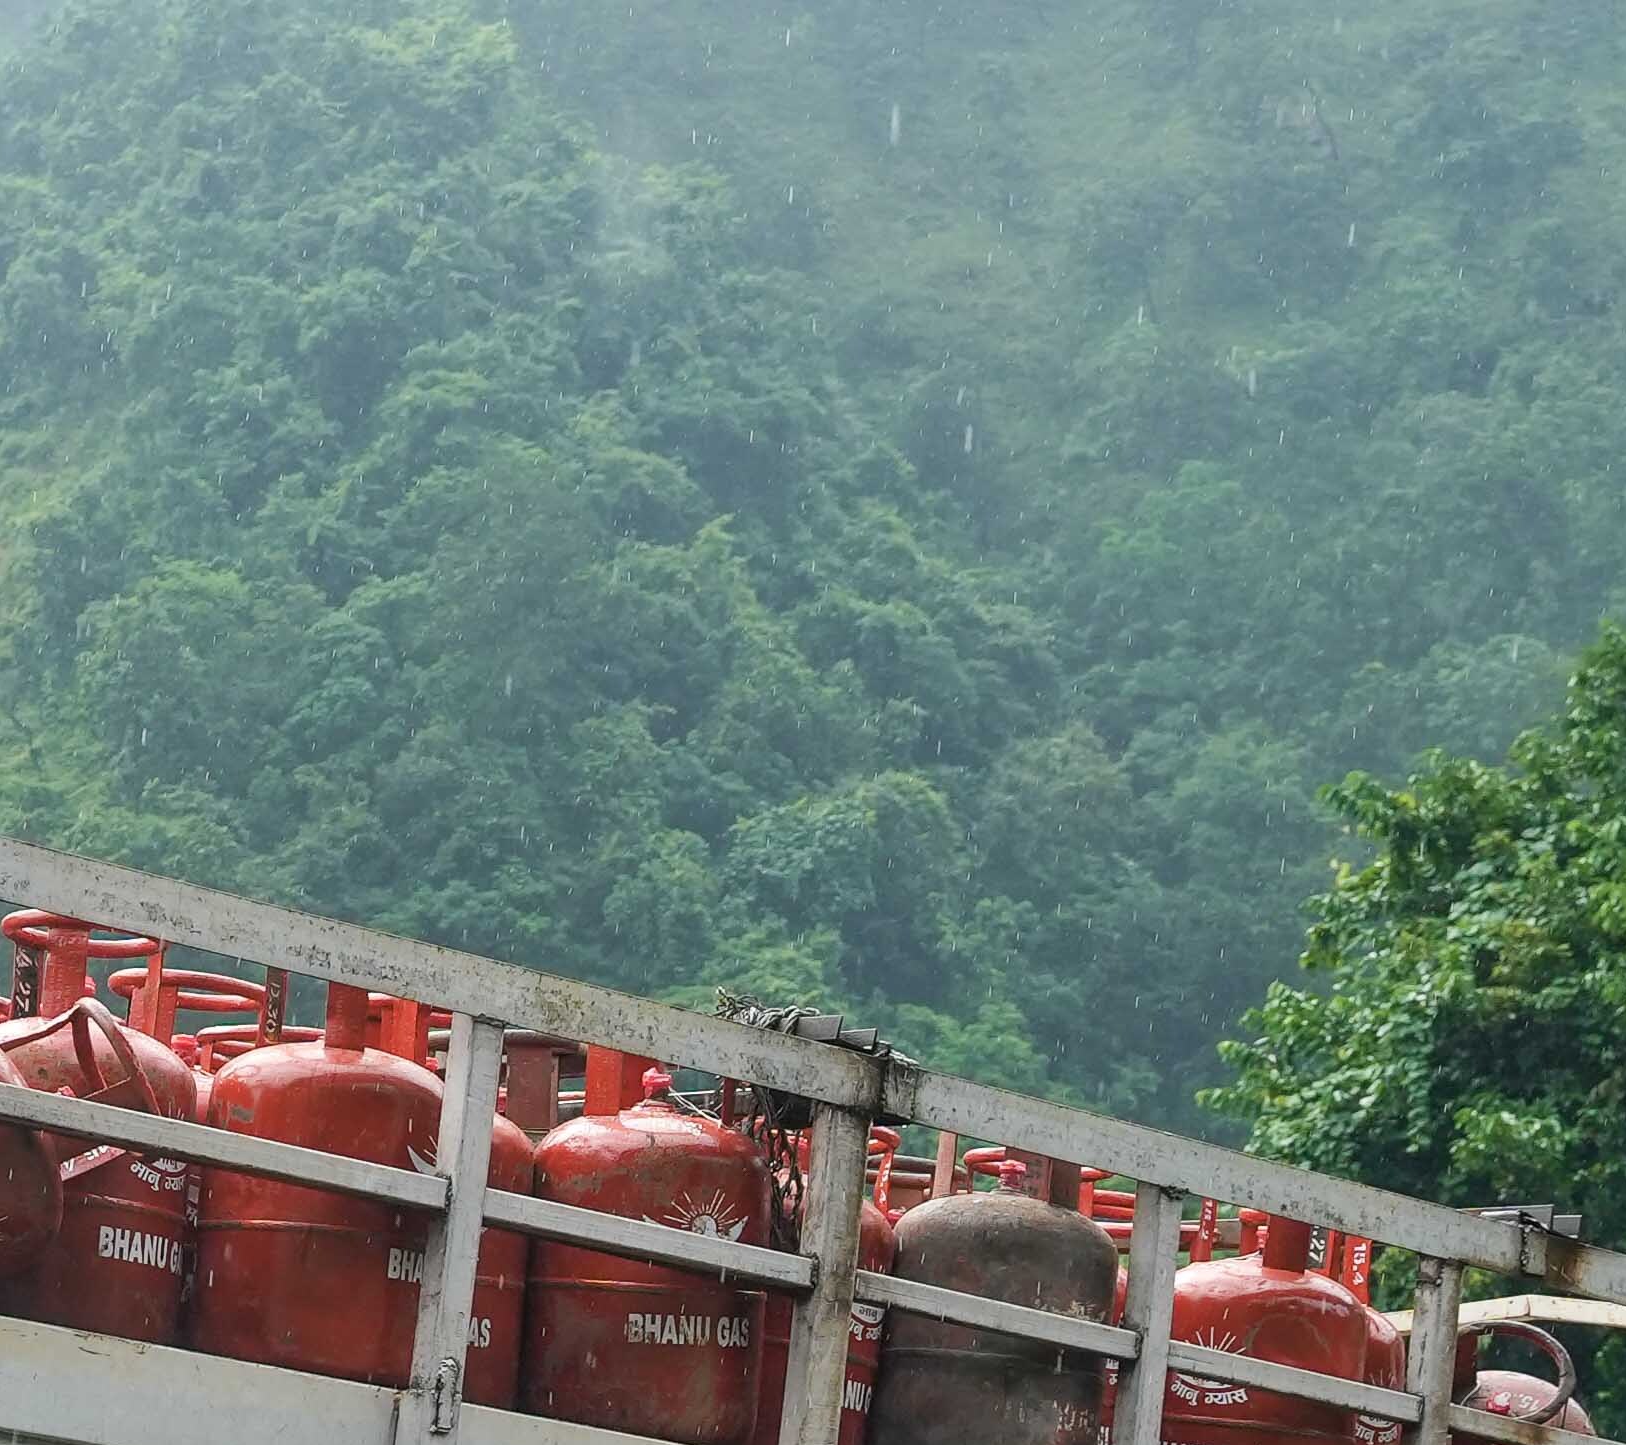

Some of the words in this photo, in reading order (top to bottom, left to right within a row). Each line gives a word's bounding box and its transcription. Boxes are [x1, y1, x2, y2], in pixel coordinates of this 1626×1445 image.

[99, 1225, 168, 1268] BHANU
[388, 1248, 425, 1283] BHA
[465, 1317, 492, 1348] AS
[627, 1313, 710, 1346] BHANU
[717, 1316, 750, 1348] GAS
